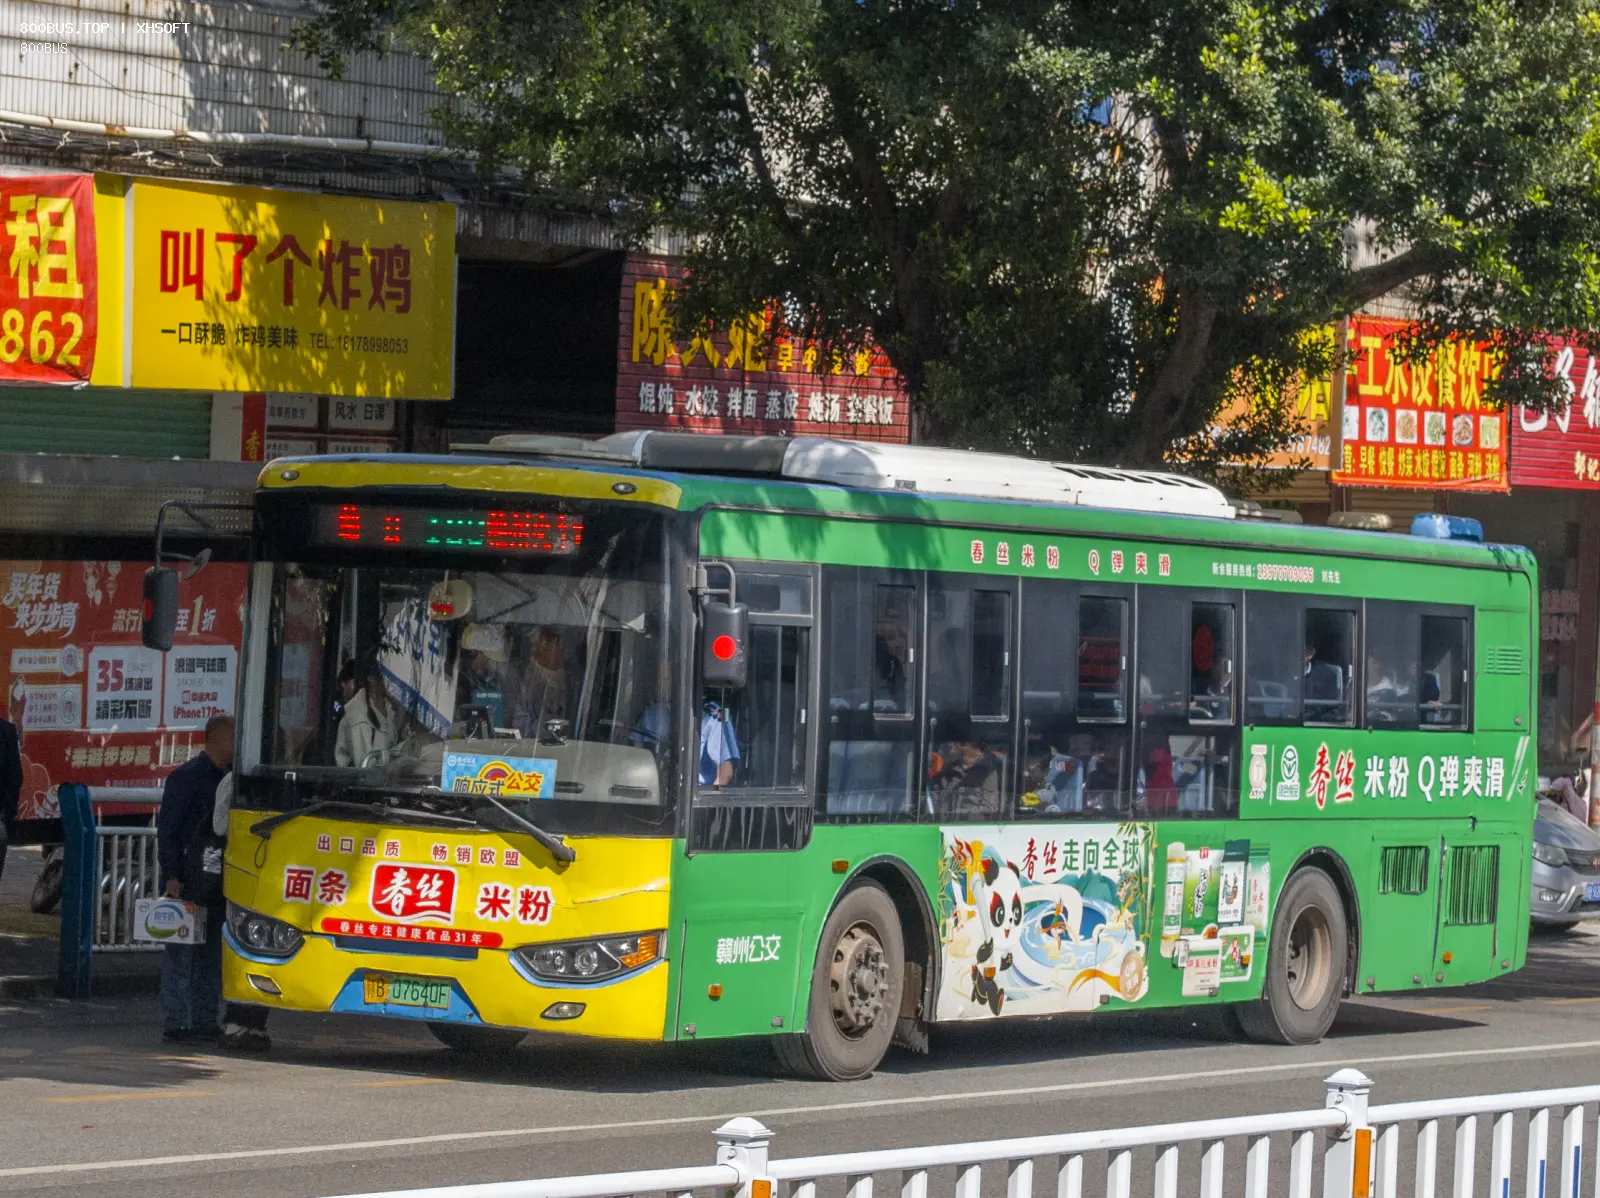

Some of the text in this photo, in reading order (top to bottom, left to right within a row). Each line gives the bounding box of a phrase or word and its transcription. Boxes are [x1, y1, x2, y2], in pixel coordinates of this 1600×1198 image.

[160, 228, 411, 314] 叫了个炸鸡
[0, 308, 84, 364] 862
[161, 322, 226, 345] 一口酥脆
[235, 324, 298, 350] 炸鸡美味
[335, 402, 356, 420] 风水
[685, 384, 718, 416] 水饺
[727, 387, 758, 419] 拌面
[765, 390, 799, 419] 蒸饺
[972, 541, 1170, 575] 春丝米粉 Q弹爽滑
[5, 571, 61, 604] 买年货
[12, 602, 79, 638] 来步步高
[96, 659, 124, 692] 35
[125, 677, 153, 691] 场演出
[96, 699, 152, 720] 精彩不断
[1306, 742, 1505, 811] 春丝 米粉 Q弹爽滑
[317, 834, 521, 867] 出口品质 畅销欧盟
[284, 866, 552, 923] 面条 春丝 米粉
[716, 934, 781, 965] 赣州公交
